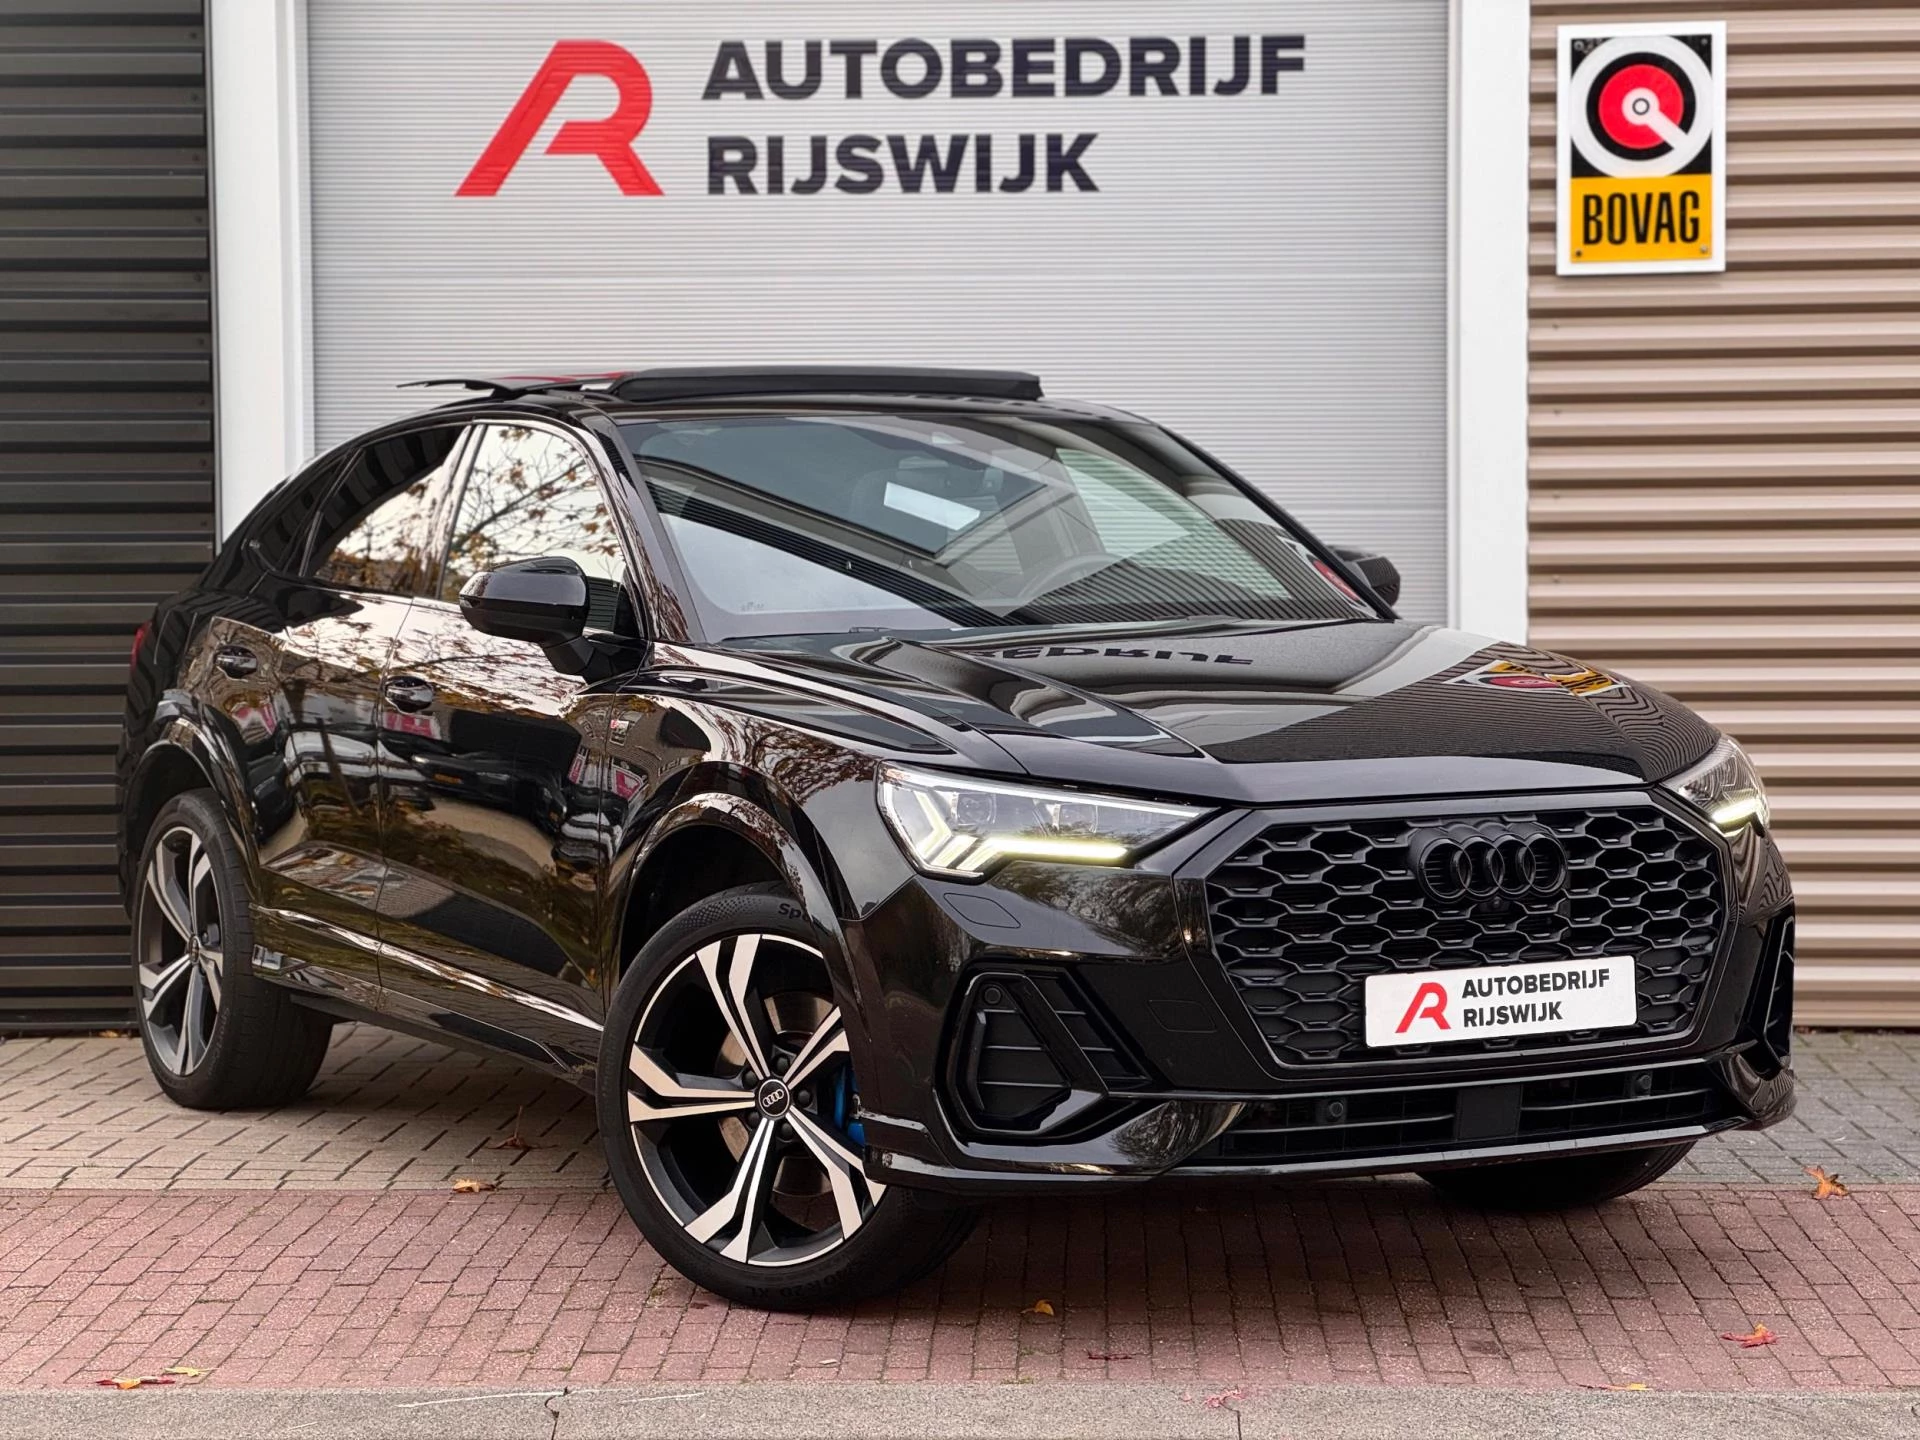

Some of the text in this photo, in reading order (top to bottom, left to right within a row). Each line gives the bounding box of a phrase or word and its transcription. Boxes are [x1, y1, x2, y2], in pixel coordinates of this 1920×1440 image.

[702, 35, 1306, 99] AUTOBEDRIJF
[708, 133, 1099, 195] RIJSWIJK
[1583, 191, 1700, 245] BOVAG
[1462, 968, 1610, 998] AUTOBEDRIJF
[1463, 1002, 1562, 1028] RIJSWIJK
